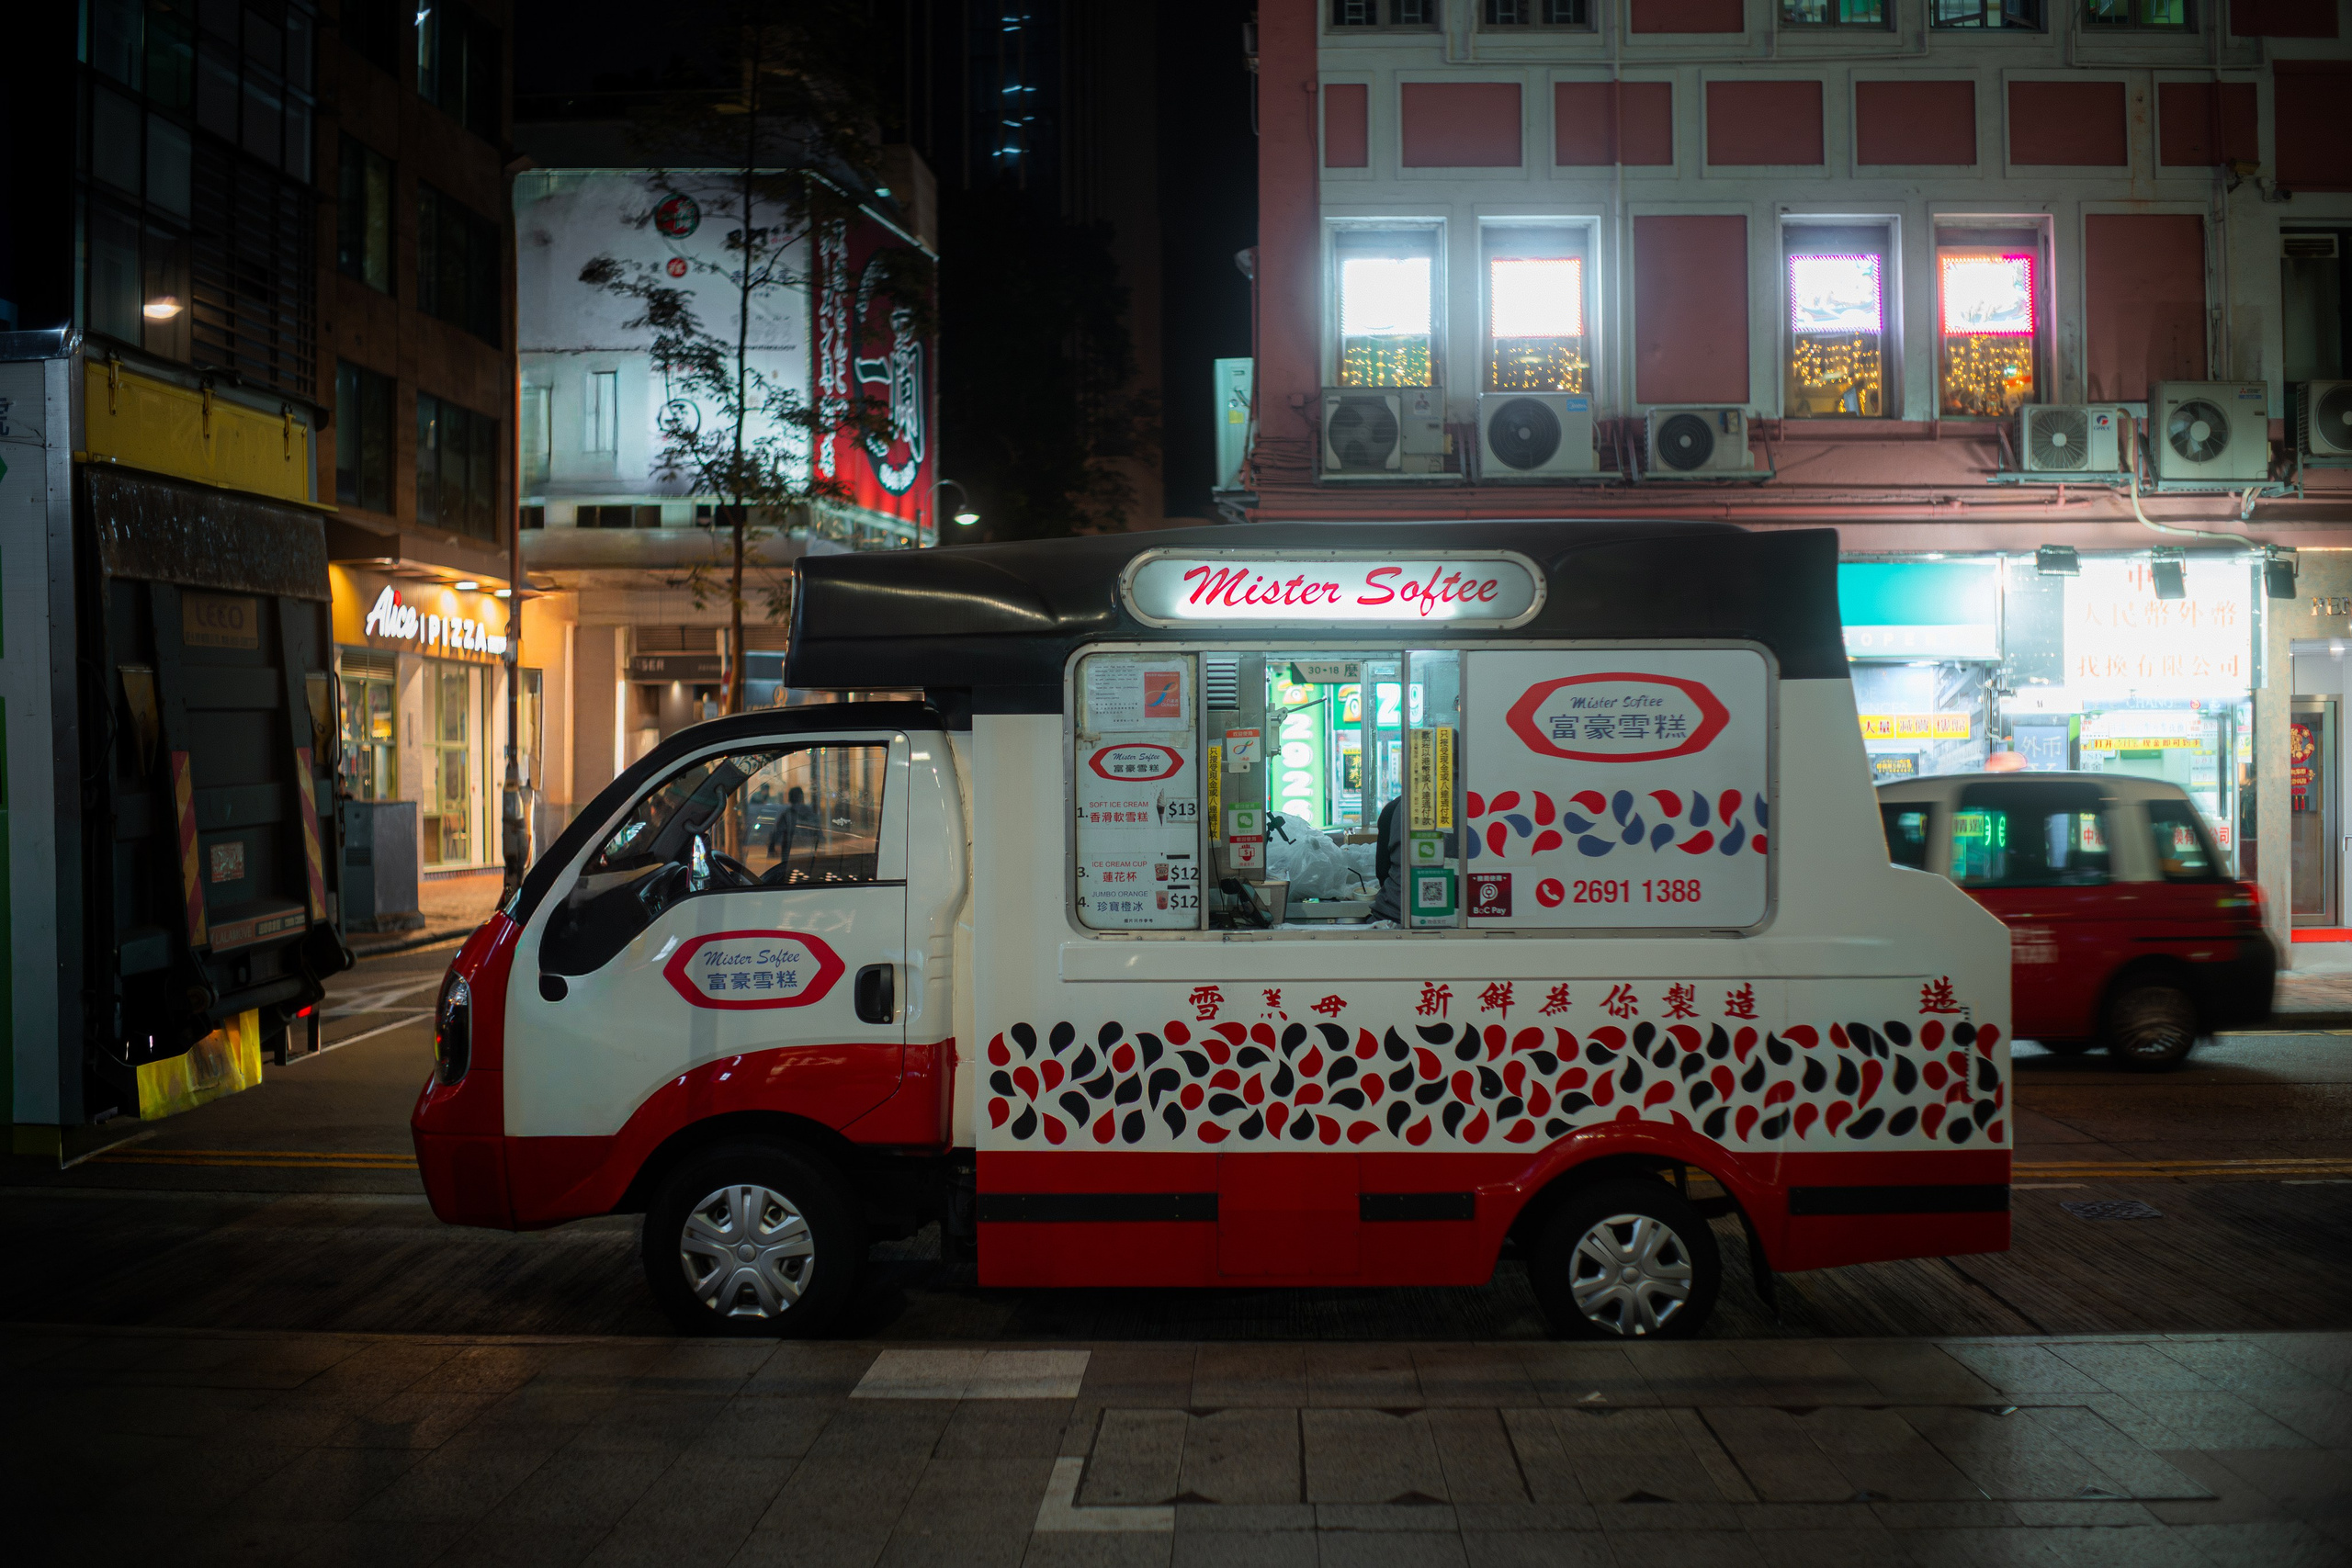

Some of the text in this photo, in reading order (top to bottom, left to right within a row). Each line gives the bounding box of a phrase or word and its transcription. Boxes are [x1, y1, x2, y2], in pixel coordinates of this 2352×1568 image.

[1183, 565, 1498, 617] Mister Softee
[365, 584, 419, 640] Alice
[428, 614, 488, 653] PIZZA
[2085, 599, 2238, 629] 人民幣外幣
[2077, 653, 2239, 678] 找換有限公司
[1570, 694, 1664, 709] Mister Softee
[1549, 714, 1687, 739] 富豪雪糕
[1113, 752, 1160, 762] Mister Softee
[1114, 764, 1159, 773] 富豪雪糕
[1090, 812, 1148, 823] 香滑軟雪糕
[1169, 801, 1196, 818] $13
[1102, 871, 1137, 883] 蓮花杯
[1170, 865, 1199, 882] $12
[1573, 879, 1702, 903] 2691 1388
[1097, 901, 1144, 912] 珍寶橙冰
[1170, 893, 1199, 910] $12
[1473, 906, 1507, 915] BoC Pay
[703, 949, 800, 968] Mister Softee
[707, 970, 797, 991] 富豪雪糕
